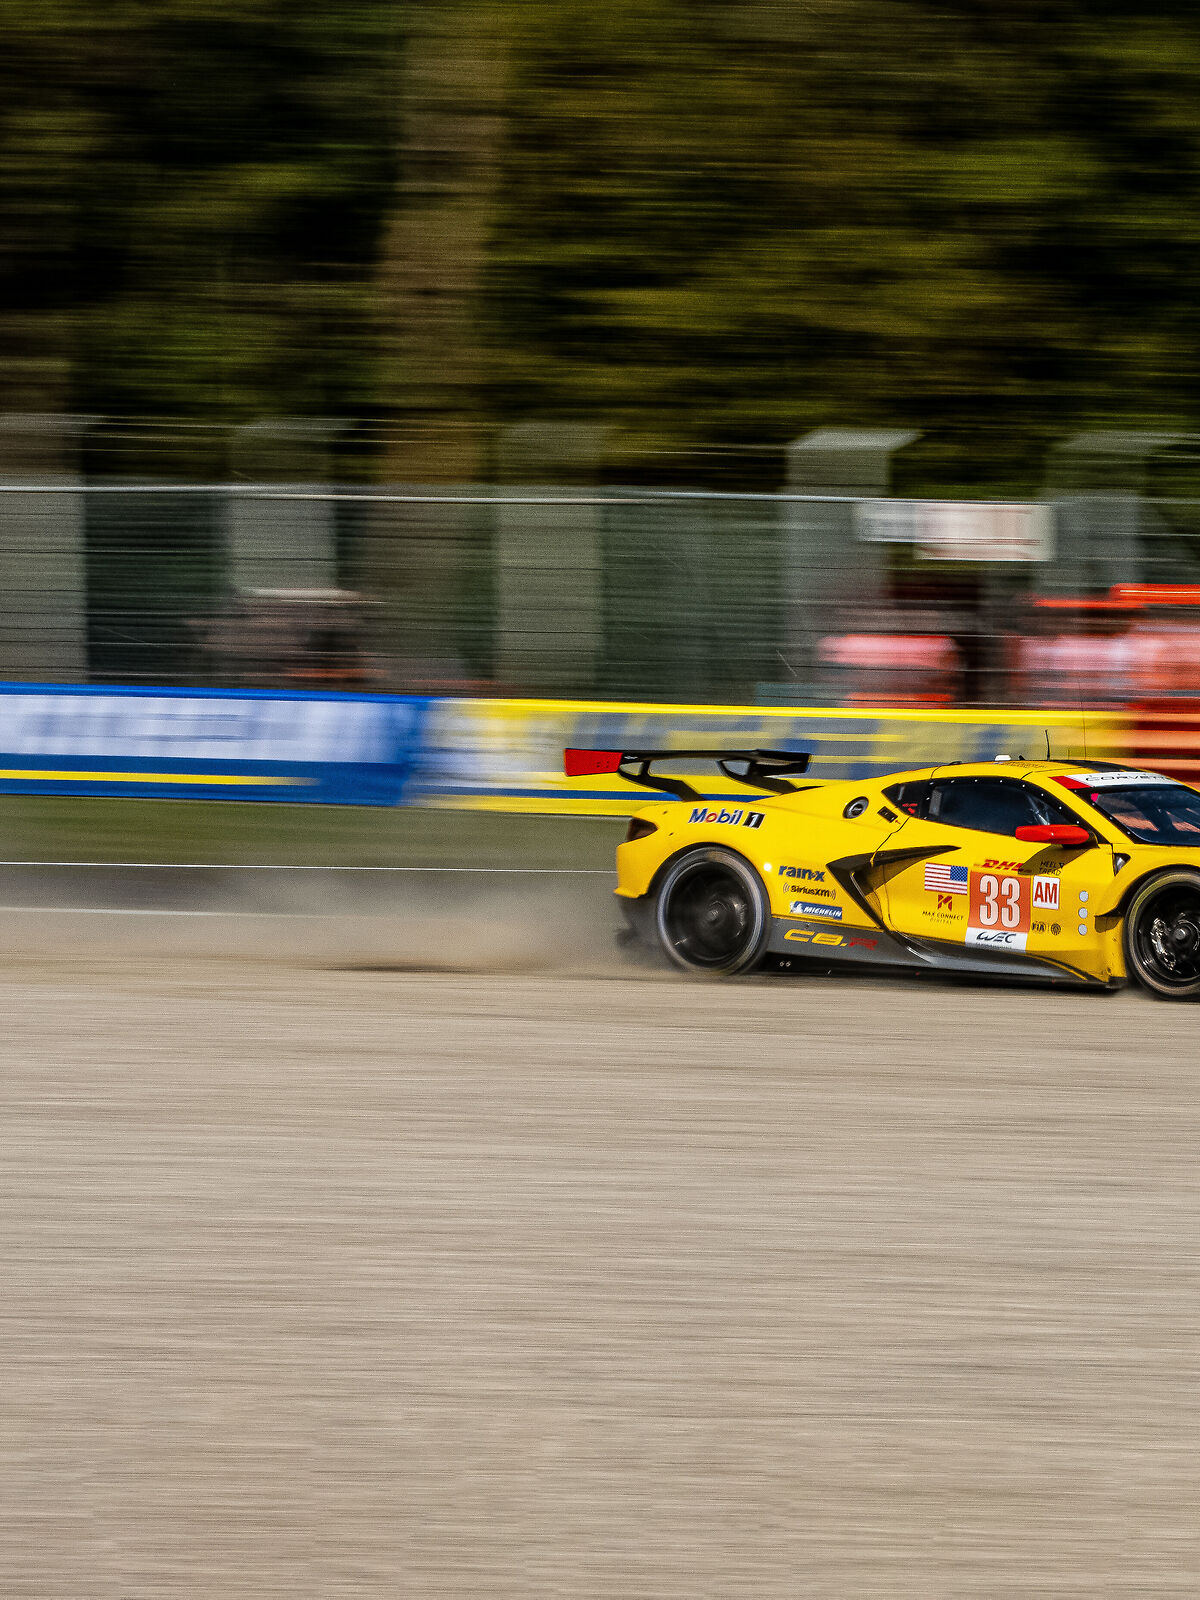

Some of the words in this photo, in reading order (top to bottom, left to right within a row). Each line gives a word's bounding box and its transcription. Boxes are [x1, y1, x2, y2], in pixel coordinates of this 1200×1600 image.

[688, 808, 743, 825] Mobil
[748, 814, 759, 828] 1
[981, 859, 1025, 872] DHL
[979, 874, 1020, 928] 33
[1034, 881, 1058, 904] AM
[803, 906, 842, 917] MICHELIN
